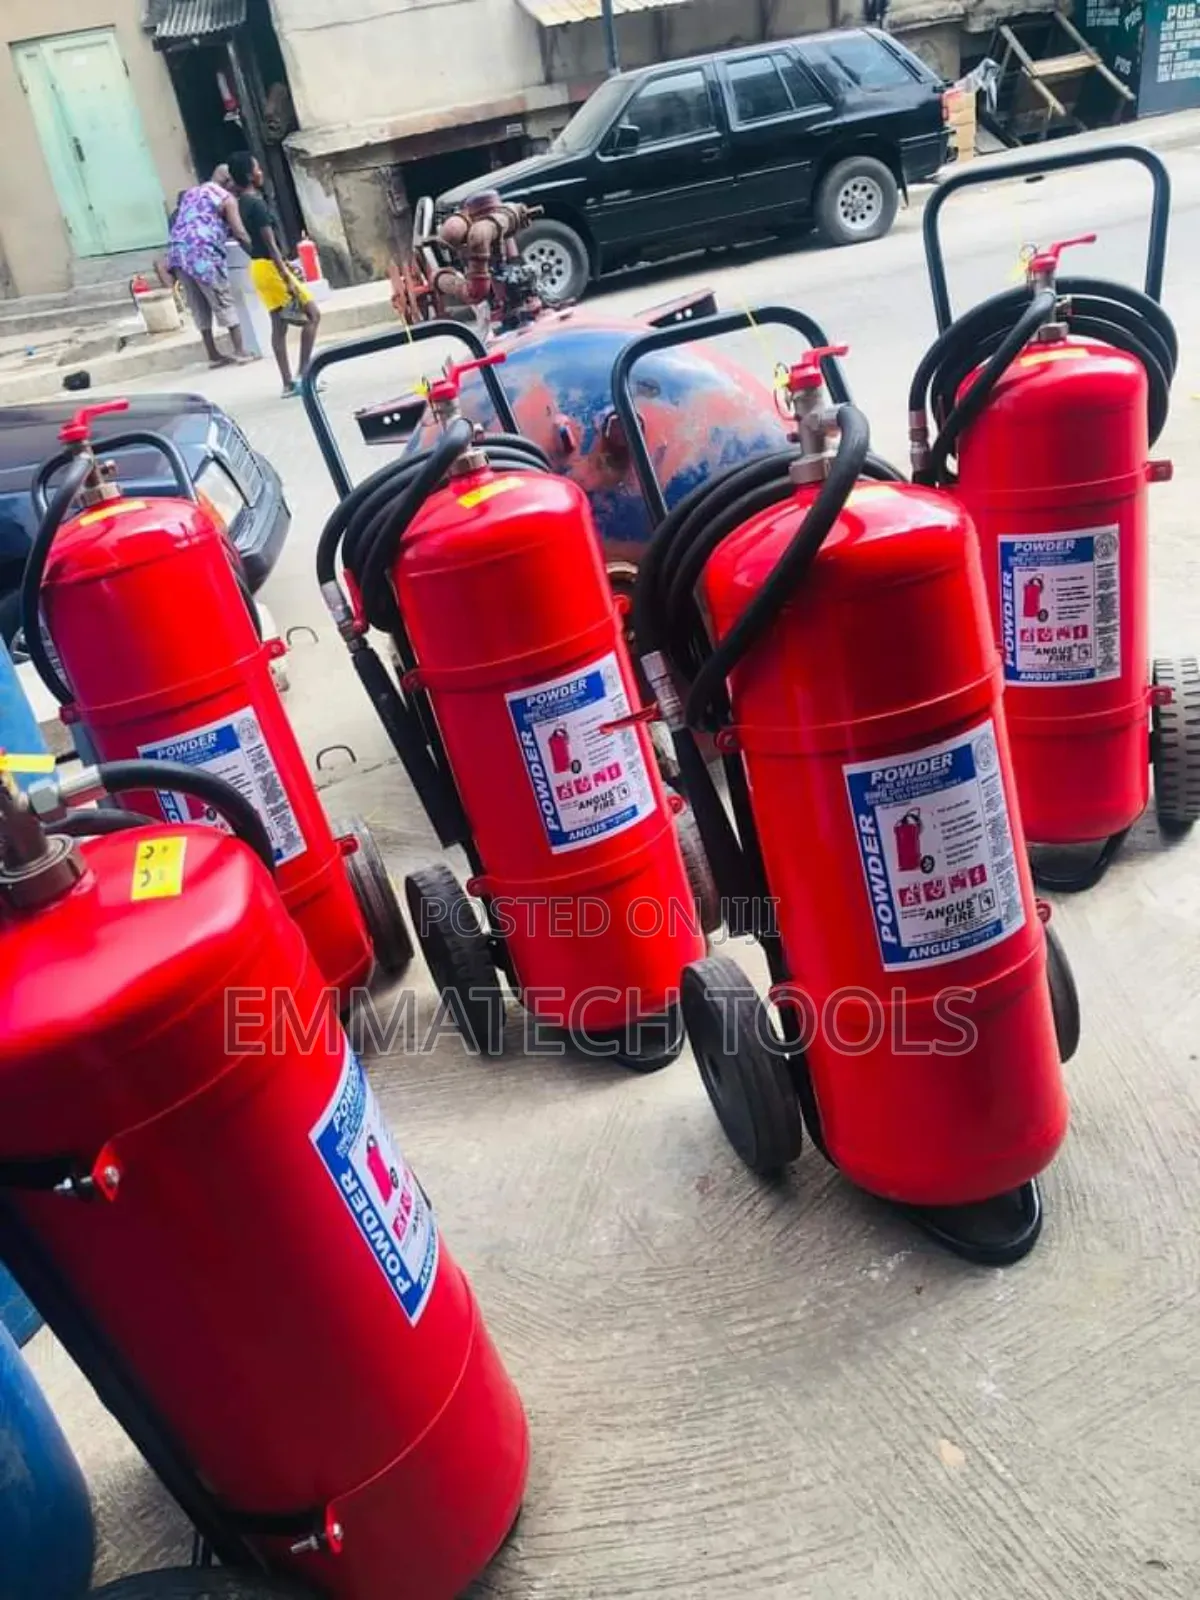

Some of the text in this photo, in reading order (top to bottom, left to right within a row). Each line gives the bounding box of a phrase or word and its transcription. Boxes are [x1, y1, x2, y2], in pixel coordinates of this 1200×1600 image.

[1167, 3, 1196, 20] POS
[1013, 539, 1076, 553] POWDER
[1003, 571, 1015, 667] POWDER
[1035, 646, 1072, 656] ANGUS
[1019, 672, 1058, 681] ANGUS
[526, 679, 588, 708] POWDER
[157, 732, 218, 760] POWDER
[871, 753, 953, 786] POWDER
[520, 730, 560, 832] POWDER
[578, 789, 614, 810] ANGUS
[593, 799, 615, 813] FIRE
[568, 823, 607, 841] ANGUS
[858, 813, 897, 944] POWDER
[925, 897, 974, 921] ANGUS
[945, 907, 976, 927] FIRE
[908, 939, 961, 959] ANGUS
[340, 1167, 412, 1295] POWDER
